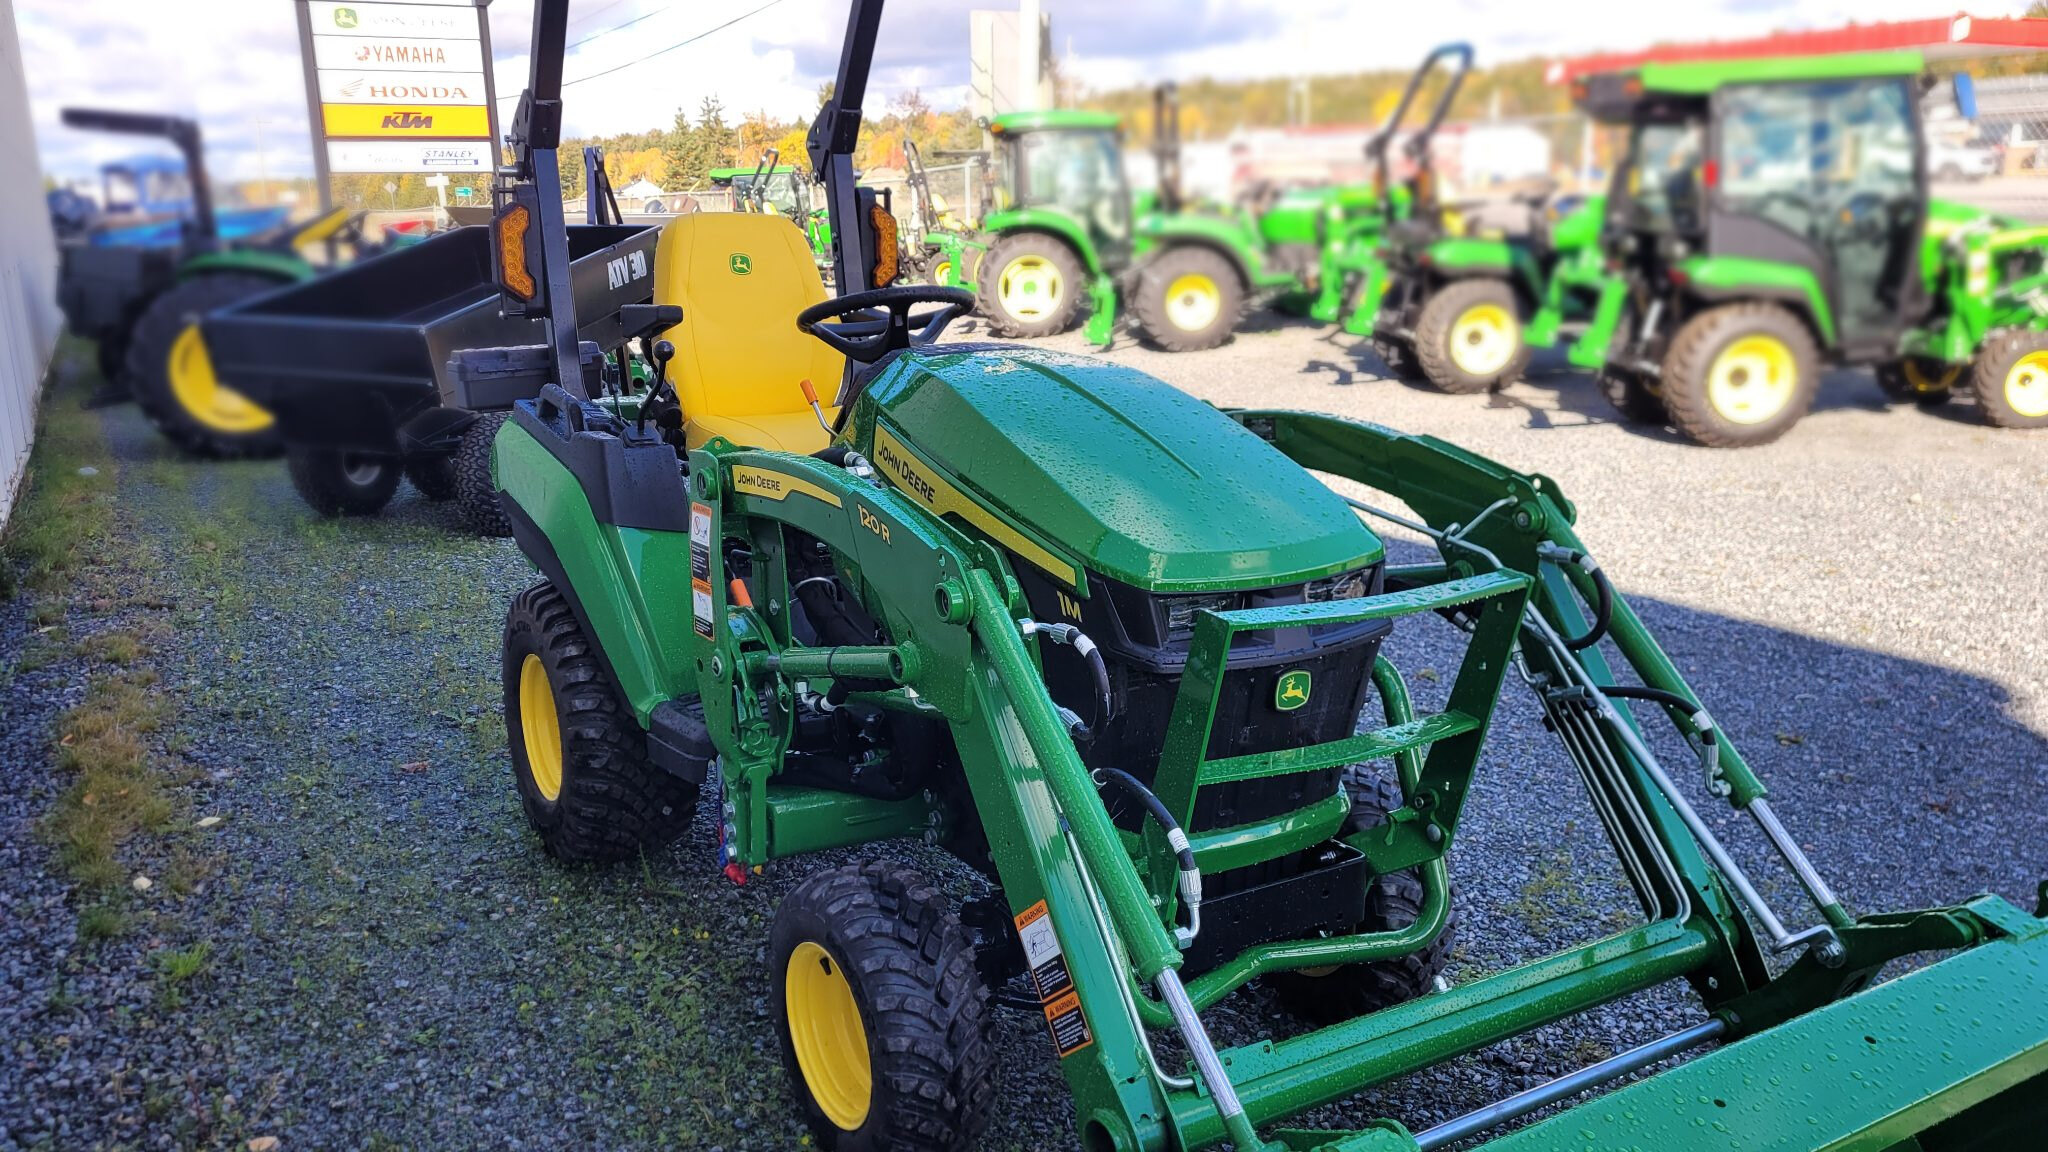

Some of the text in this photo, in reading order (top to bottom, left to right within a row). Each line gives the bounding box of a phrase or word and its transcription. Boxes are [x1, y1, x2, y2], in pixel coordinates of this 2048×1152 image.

[373, 46, 446, 63] YAMAHA
[370, 86, 468, 98] HONDA
[381, 112, 433, 128] KTM
[424, 150, 474, 158] STANLEY
[607, 249, 648, 290] ATV 30
[878, 439, 936, 505] JOHN DEERE
[737, 472, 781, 492] JOHN DEERE
[1056, 590, 1083, 624] 1M
